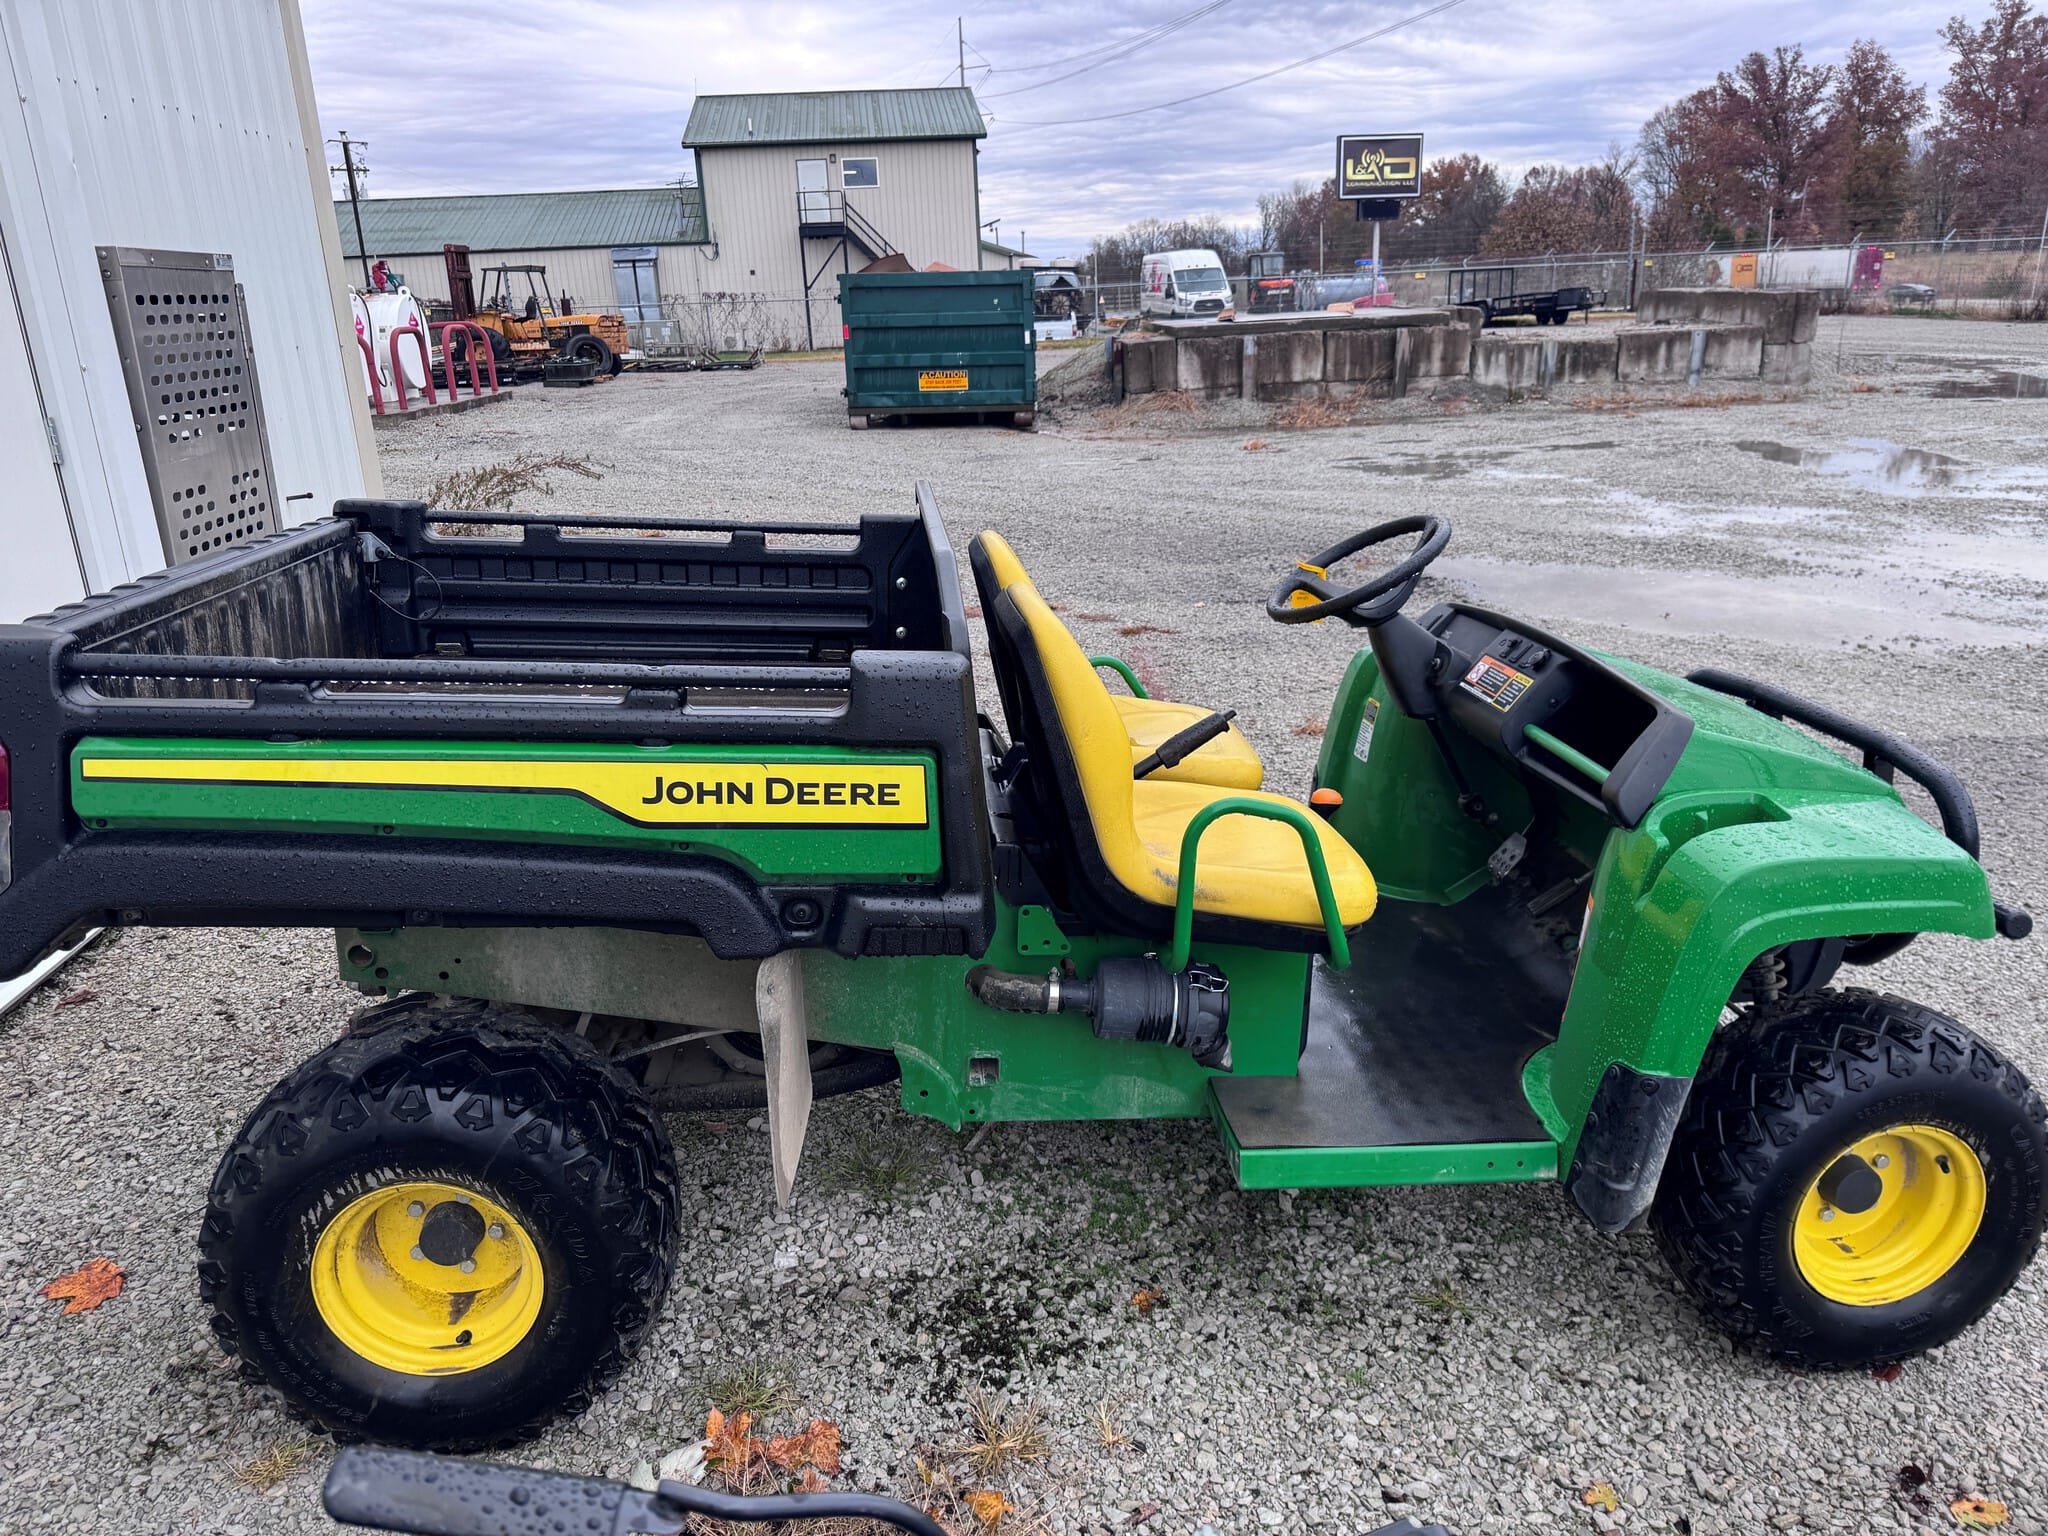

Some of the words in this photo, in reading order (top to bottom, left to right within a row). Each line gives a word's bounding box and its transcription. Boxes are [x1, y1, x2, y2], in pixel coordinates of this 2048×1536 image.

[928, 371, 966, 379] CAUTION
[642, 776, 753, 805] JOHN
[765, 777, 900, 806] DEERE
